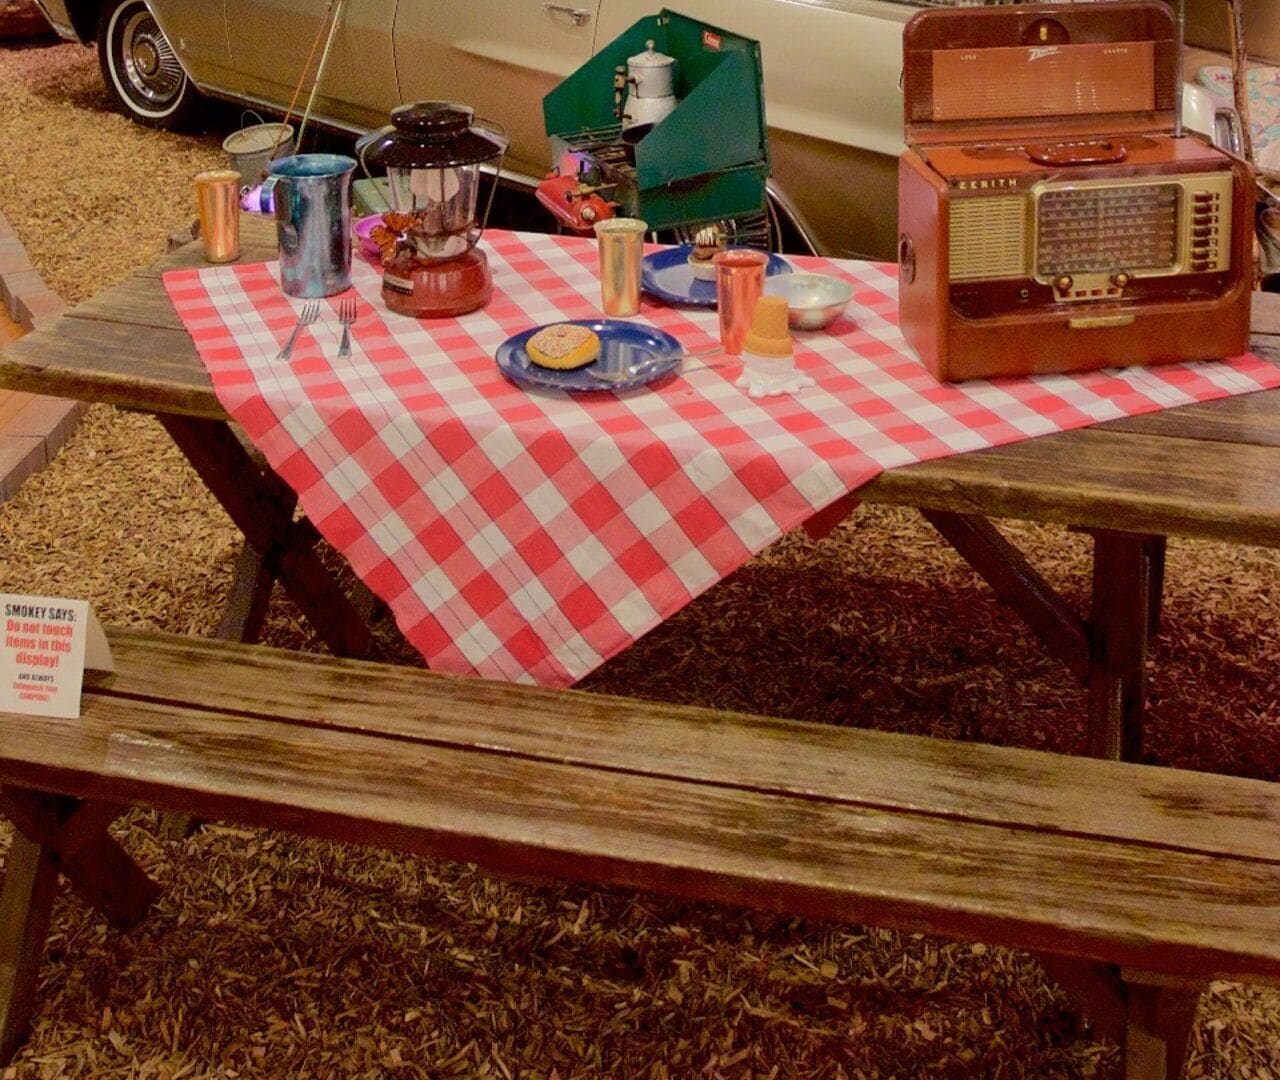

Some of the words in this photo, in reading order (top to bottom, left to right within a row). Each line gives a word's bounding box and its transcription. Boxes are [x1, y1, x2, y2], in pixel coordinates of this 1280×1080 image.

[959, 178, 1017, 190] ZENITH
[5, 604, 47, 619] SMOKEY
[49, 608, 77, 622] SAYS:
[6, 619, 21, 632] Do
[23, 622, 40, 634] not
[43, 624, 73, 637] touch
[38, 639, 49, 651] in
[51, 639, 72, 653] this
[16, 651, 60, 668] display!
